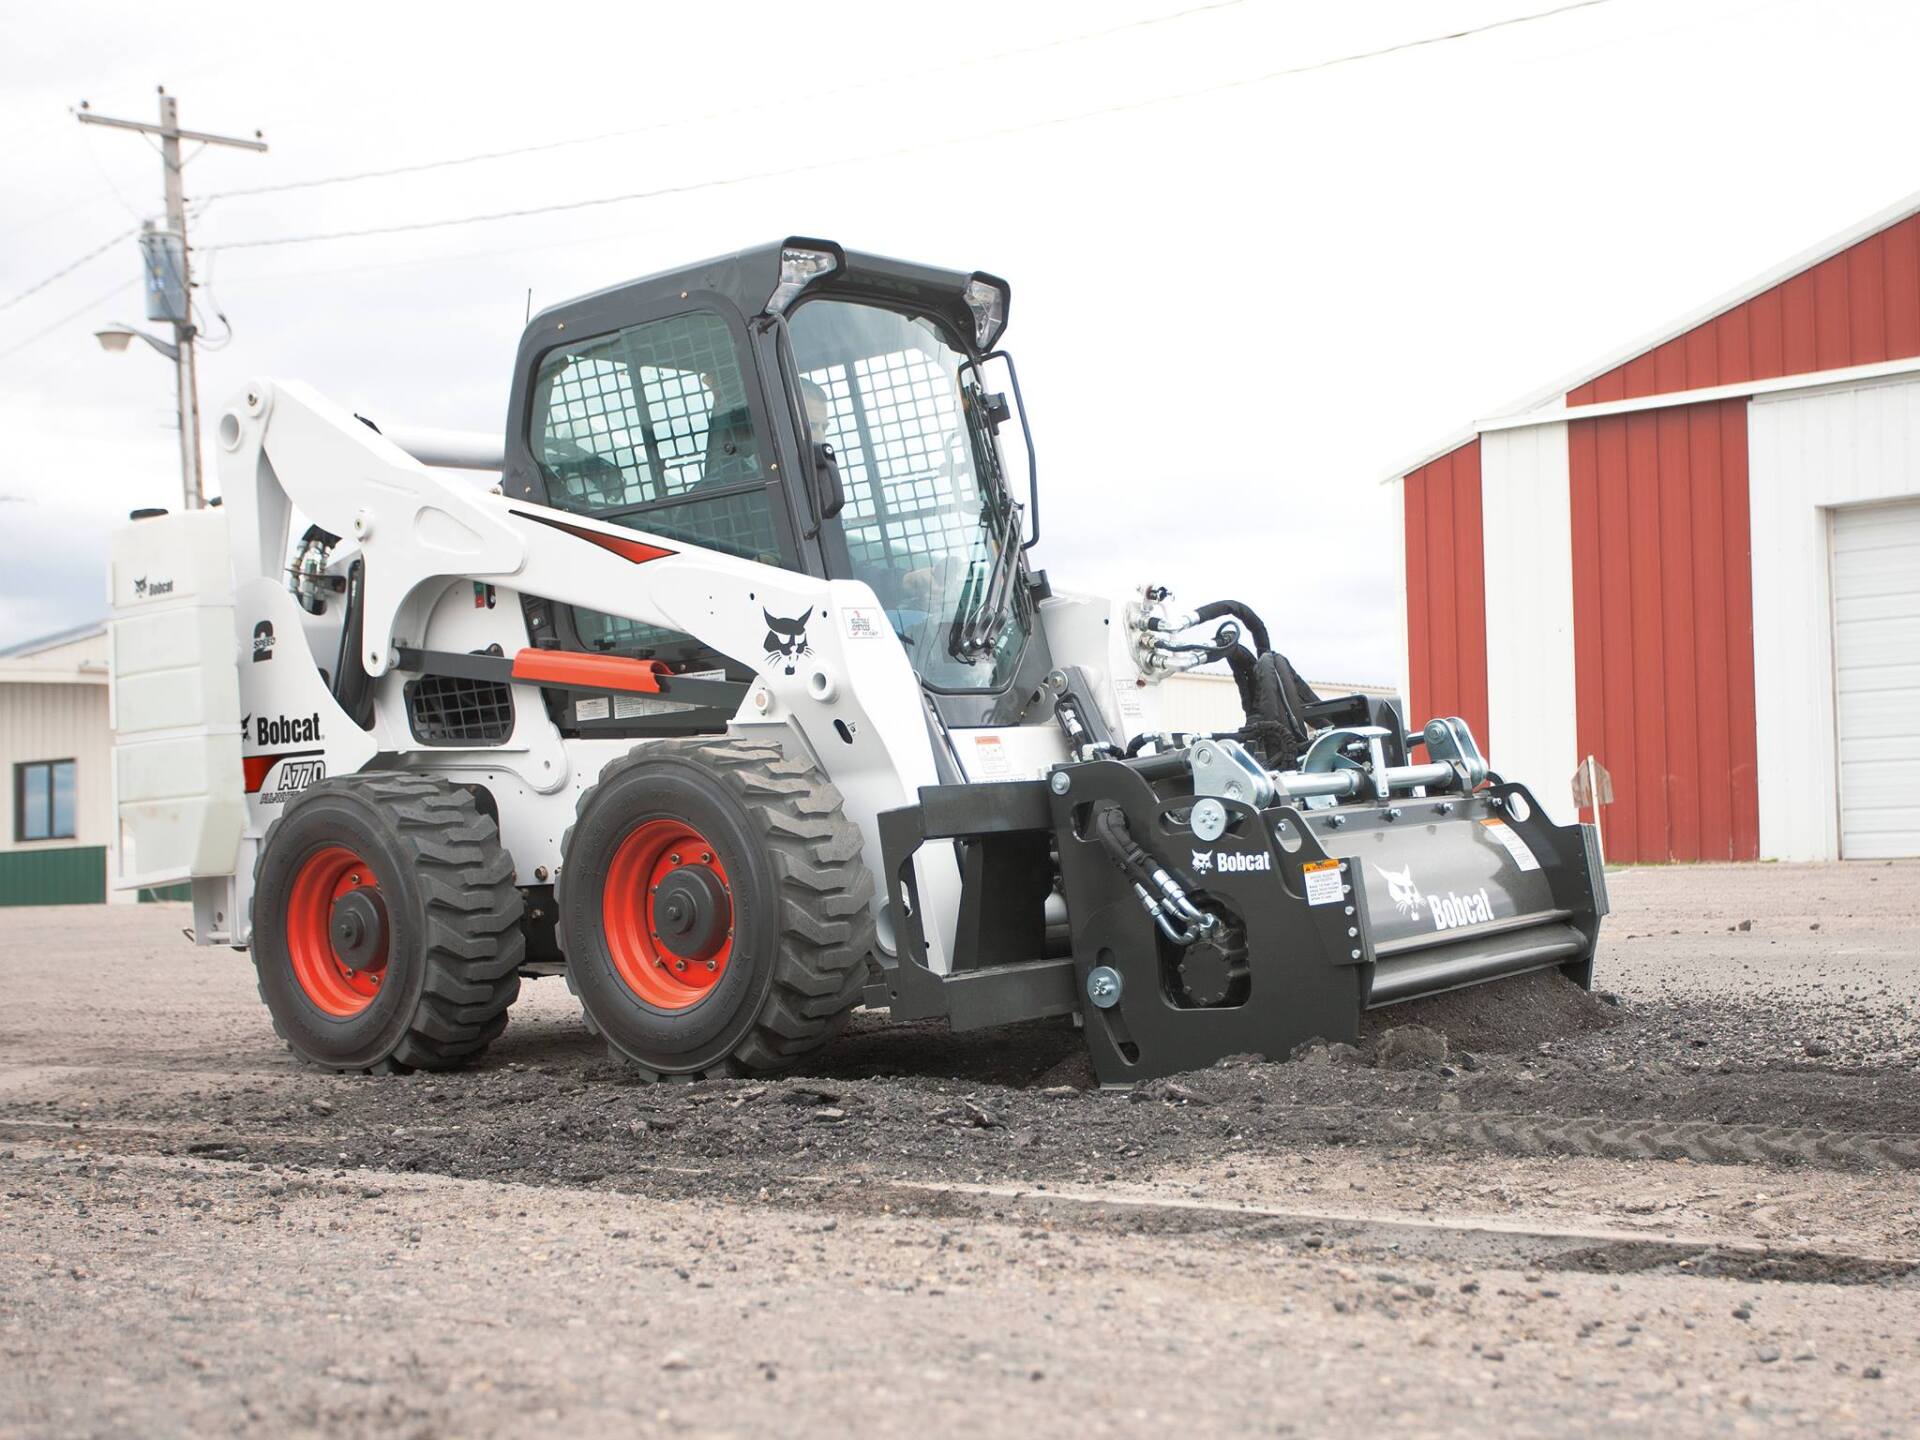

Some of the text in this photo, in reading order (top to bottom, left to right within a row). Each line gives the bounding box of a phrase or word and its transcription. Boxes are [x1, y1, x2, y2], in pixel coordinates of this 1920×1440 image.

[149, 579, 173, 596] Bobcat
[253, 620, 274, 663] 2
[253, 637, 276, 650] SPEED
[257, 712, 321, 746] Bobcat
[1216, 851, 1271, 873] Bobcat
[1426, 887, 1495, 931] Bobcat
